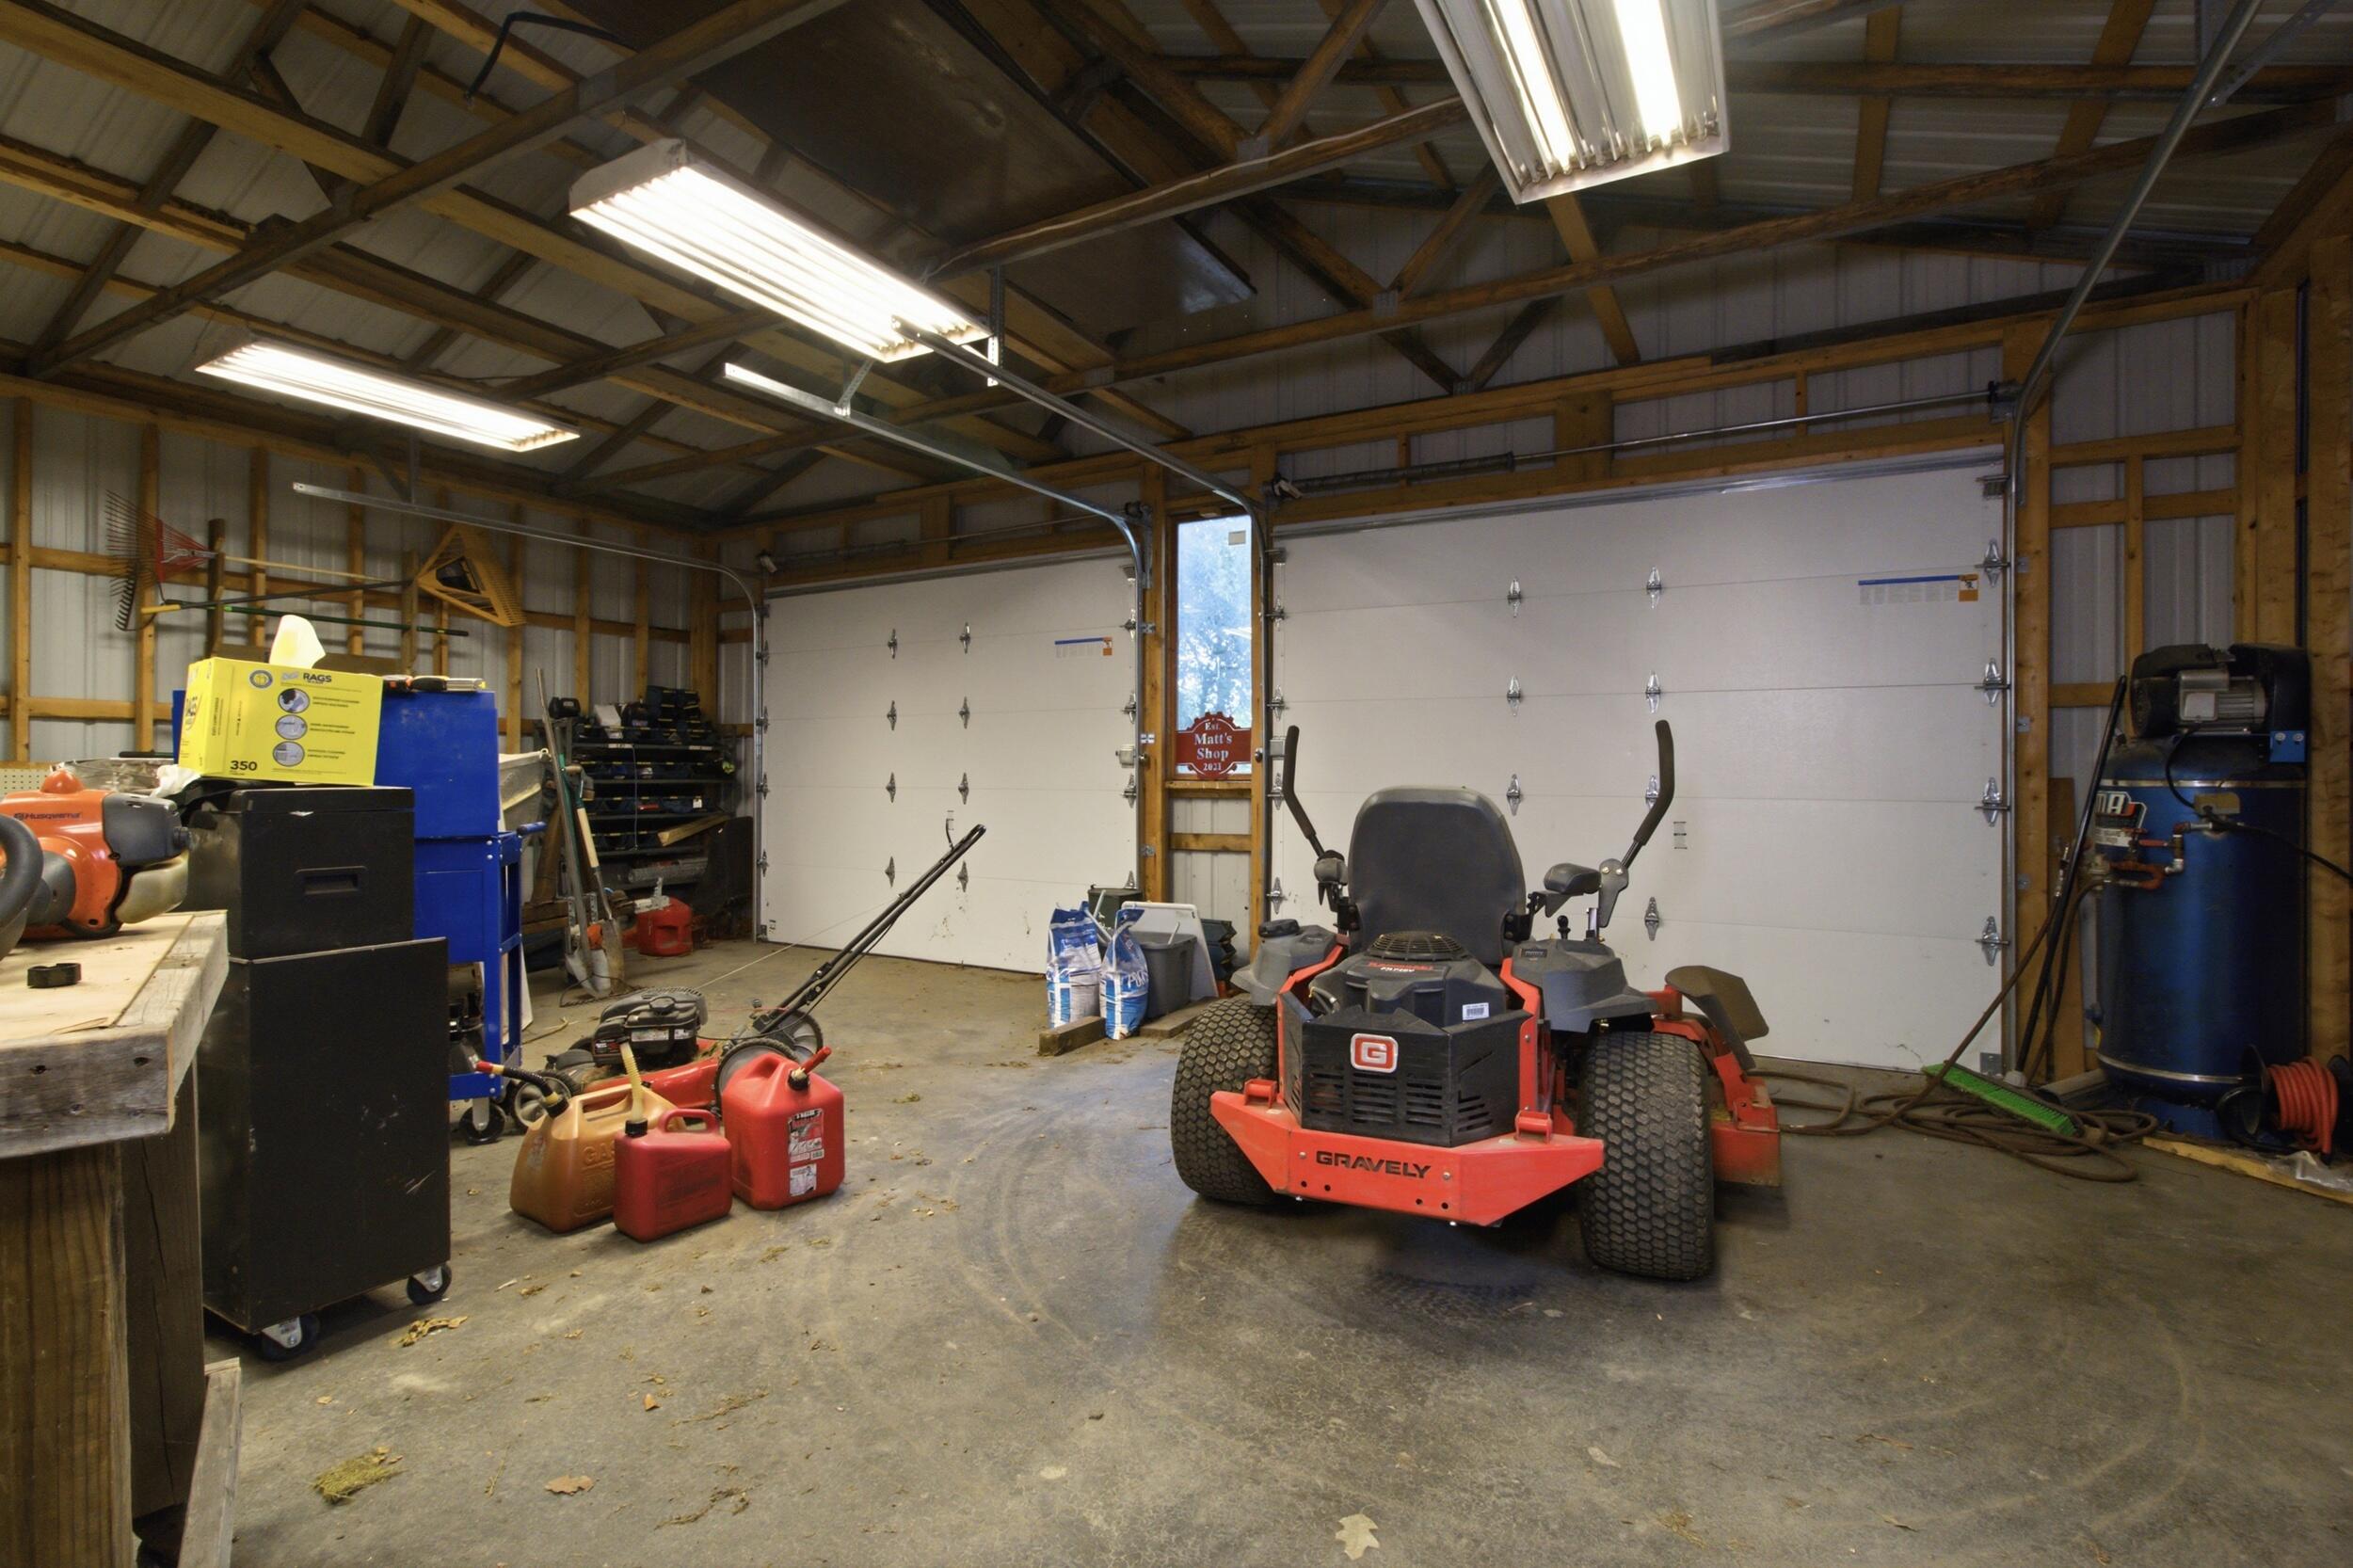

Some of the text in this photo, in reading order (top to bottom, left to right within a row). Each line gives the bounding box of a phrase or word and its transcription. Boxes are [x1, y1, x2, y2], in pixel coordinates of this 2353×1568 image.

[302, 672, 332, 682] RAGS
[1194, 732, 1233, 745] Matt's
[1196, 747, 1229, 761] Shop
[230, 760, 258, 771] 350
[1361, 1041, 1387, 1064] G
[1316, 1150, 1432, 1179] GRAVELY
